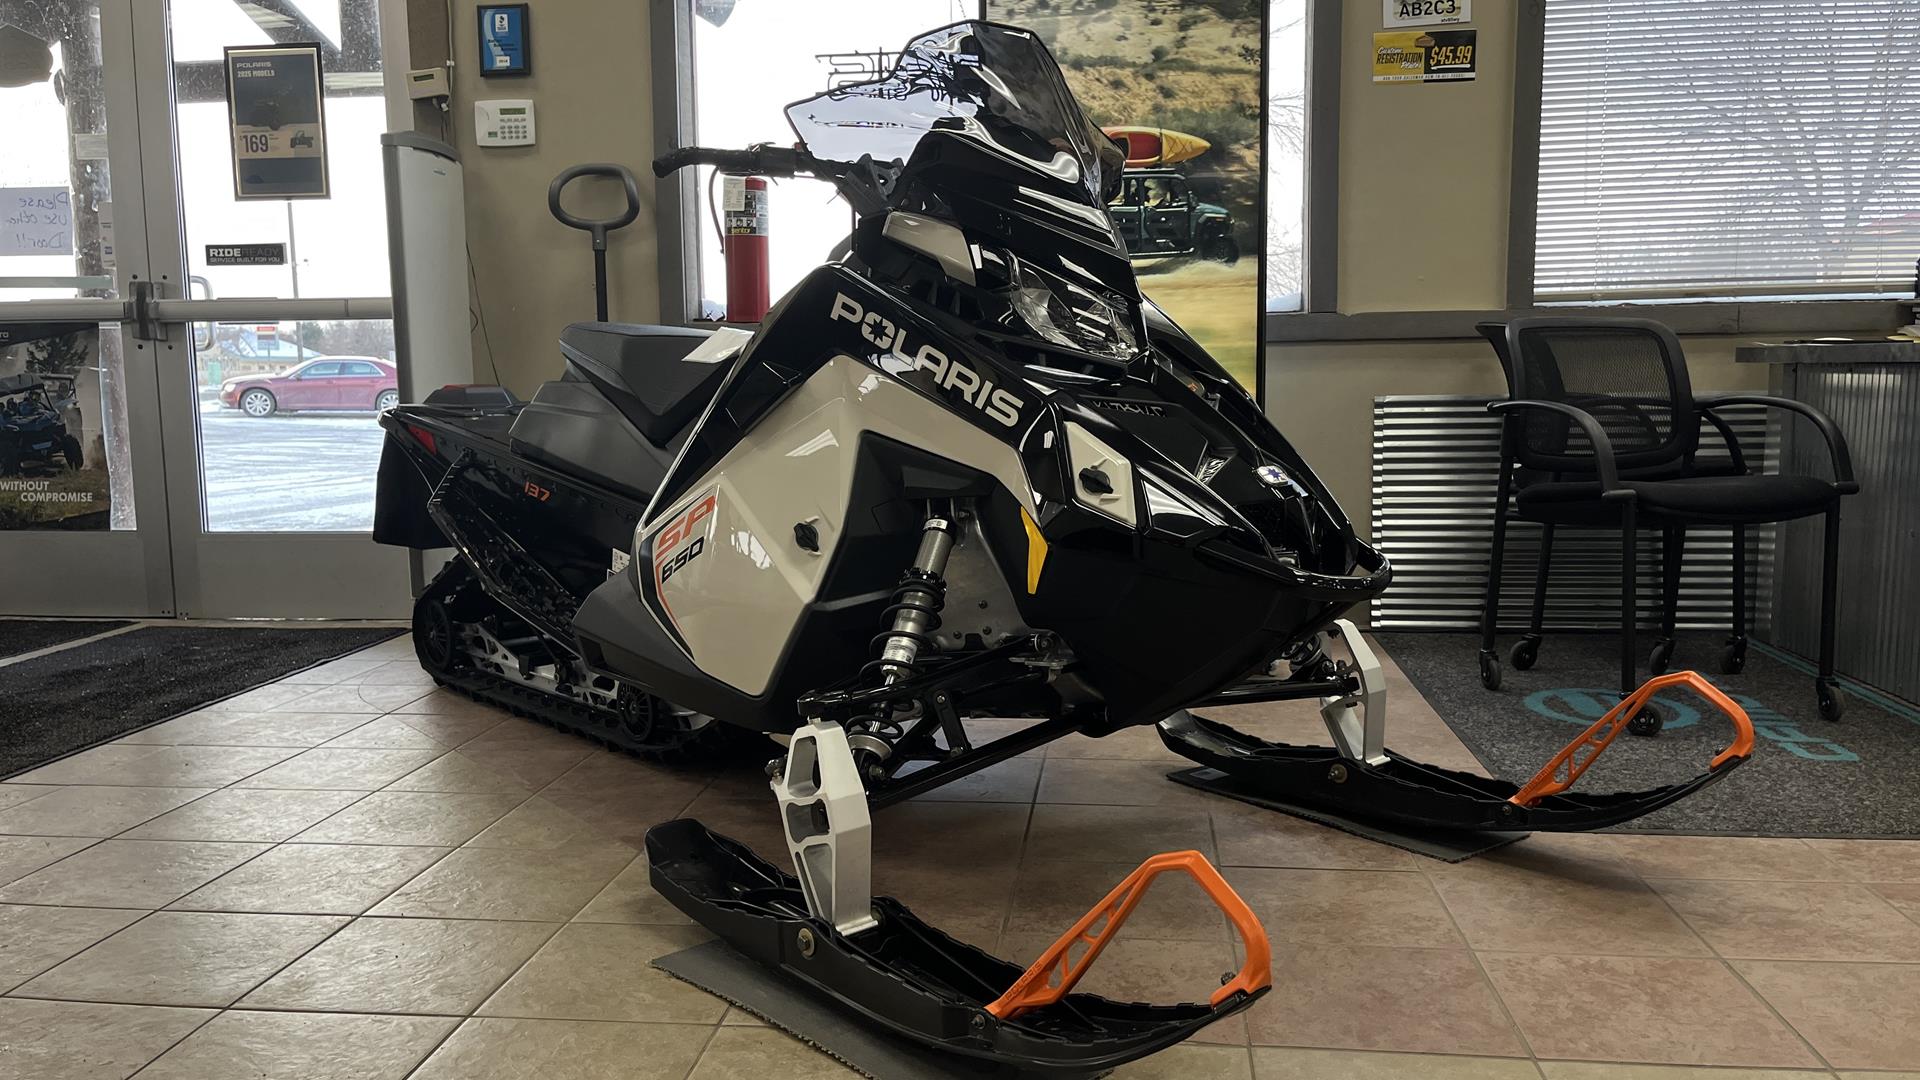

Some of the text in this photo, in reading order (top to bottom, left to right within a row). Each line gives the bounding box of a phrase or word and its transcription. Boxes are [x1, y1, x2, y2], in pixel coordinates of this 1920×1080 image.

[1400, 0, 1456, 17] AB2C3
[1376, 52, 1423, 64] REGISTRATION
[1430, 45, 1473, 66] $45.99
[830, 292, 1025, 427] POLARIS
[0, 481, 50, 491] WITHOUT
[525, 481, 550, 501] 137
[21, 492, 93, 502] COMPROMISE
[656, 495, 716, 560] SP
[662, 536, 705, 584] 650
